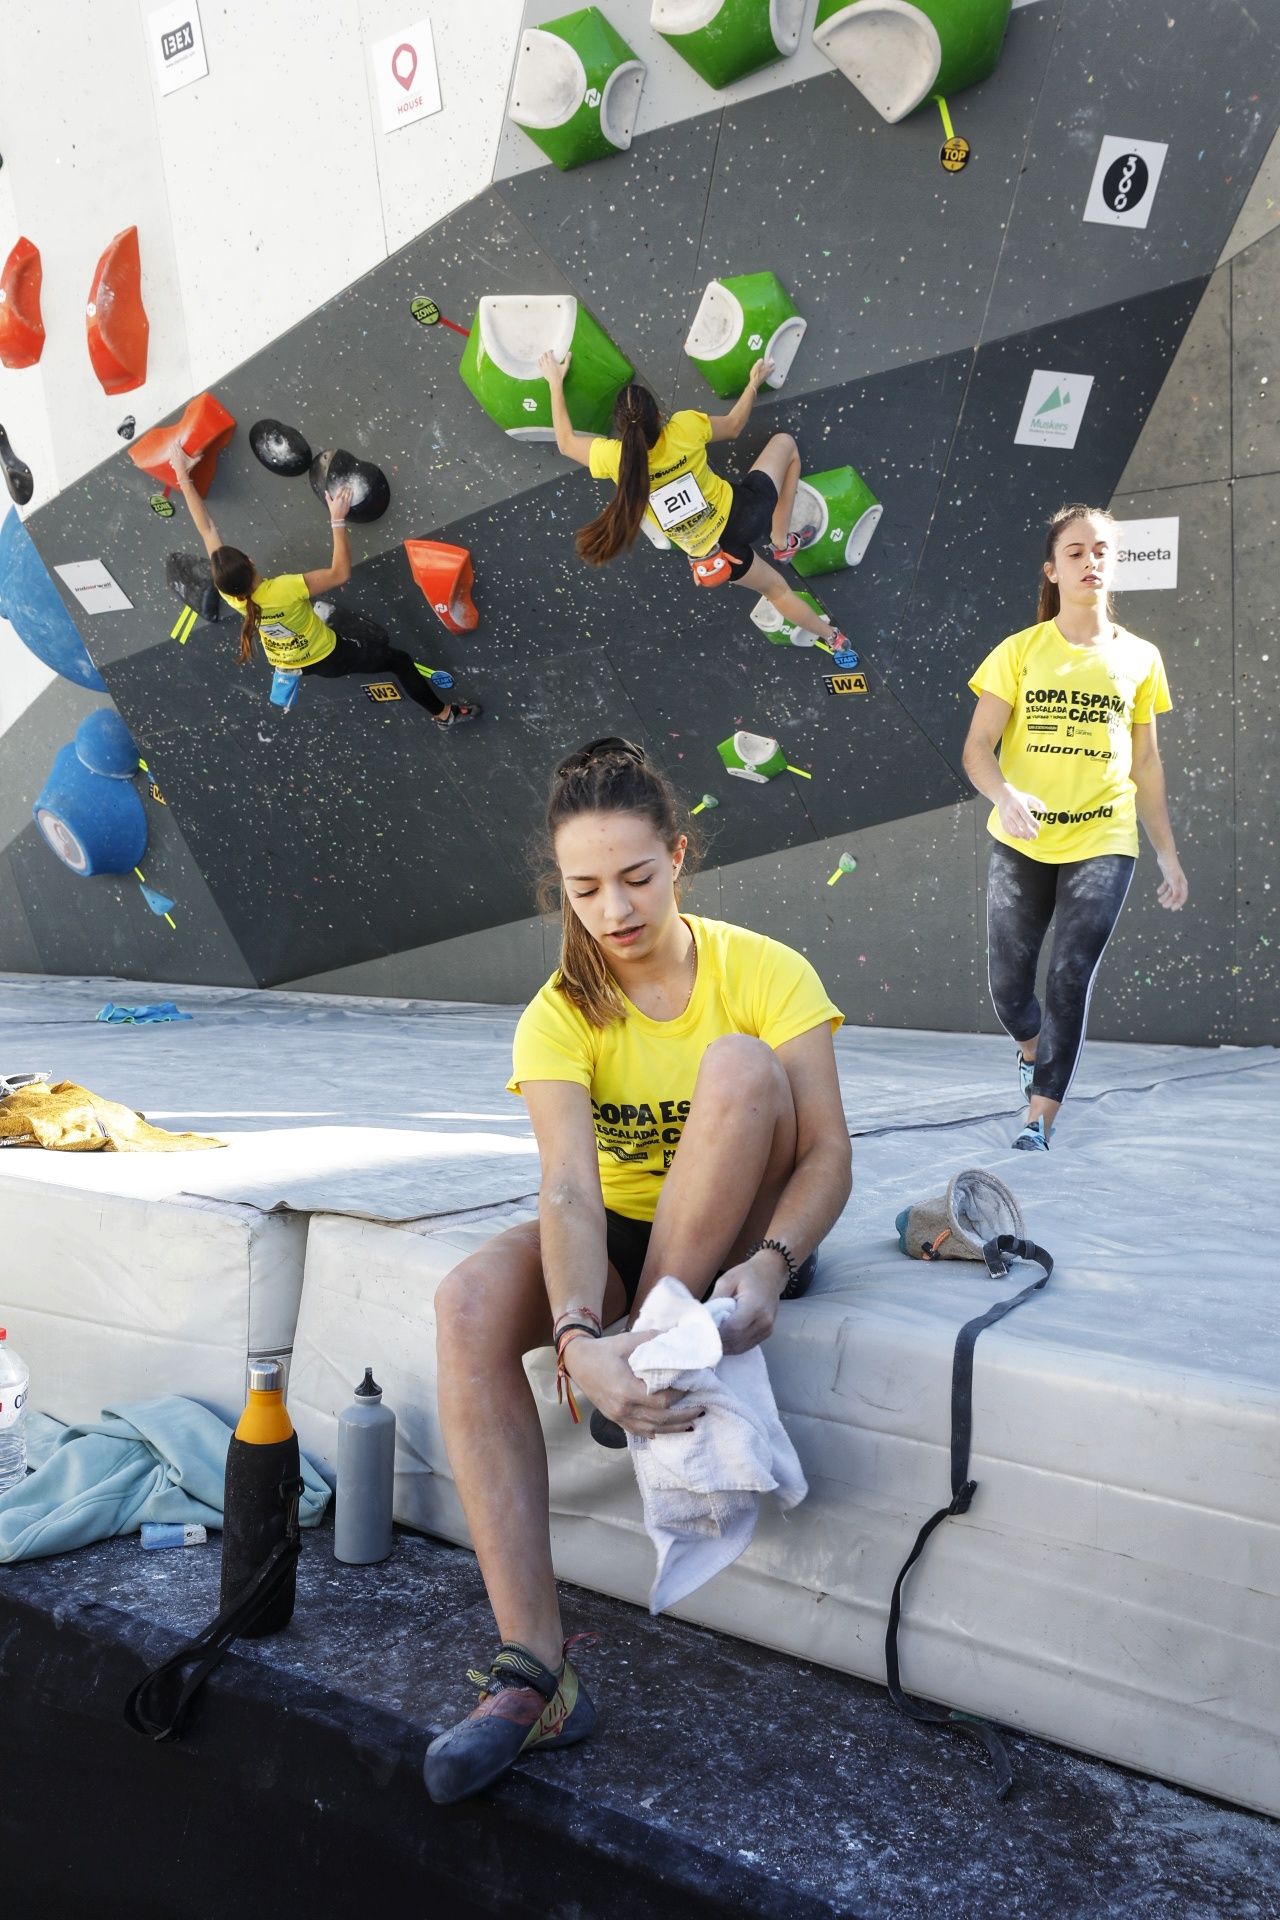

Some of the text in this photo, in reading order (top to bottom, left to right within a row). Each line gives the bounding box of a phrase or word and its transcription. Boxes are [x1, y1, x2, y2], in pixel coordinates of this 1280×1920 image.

[397, 96, 423, 115] HOUSE
[945, 149, 966, 161] TOP
[414, 304, 438, 320] ZONE
[664, 489, 691, 513] 211
[1117, 548, 1171, 563] Cheeta
[834, 656, 859, 665] START
[834, 678, 865, 691] W4
[372, 687, 398, 698] W3
[1026, 690, 1126, 715] COPA ESPAÑA
[1032, 706, 1067, 714] ESCALADA
[596, 1123, 660, 1140] ESCALADA
